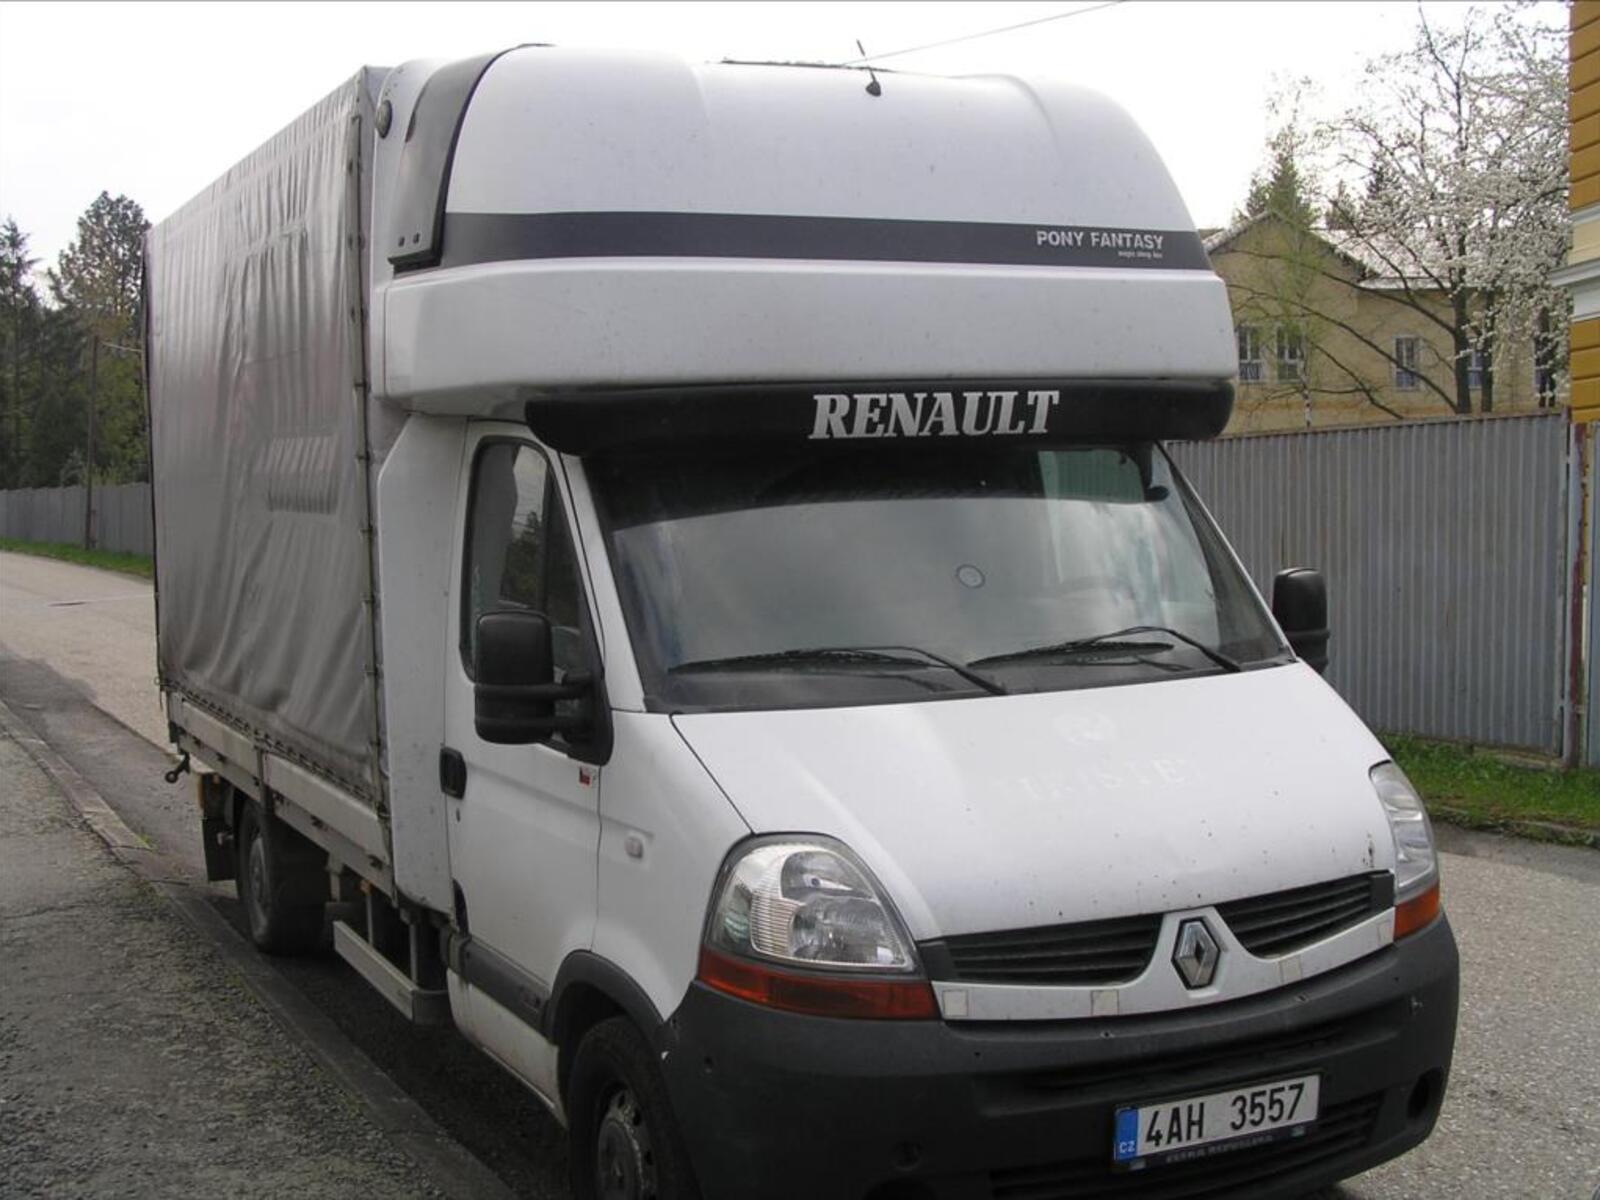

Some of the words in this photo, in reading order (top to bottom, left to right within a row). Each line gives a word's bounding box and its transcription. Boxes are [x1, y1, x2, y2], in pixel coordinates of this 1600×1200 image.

[1036, 230, 1084, 247] PONY
[1091, 231, 1164, 250] FANTASY
[808, 390, 1060, 439] RENAULT
[1145, 1102, 1205, 1147] 4AH
[1230, 1082, 1305, 1132] 3557
[1119, 1140, 1136, 1154] CZ
